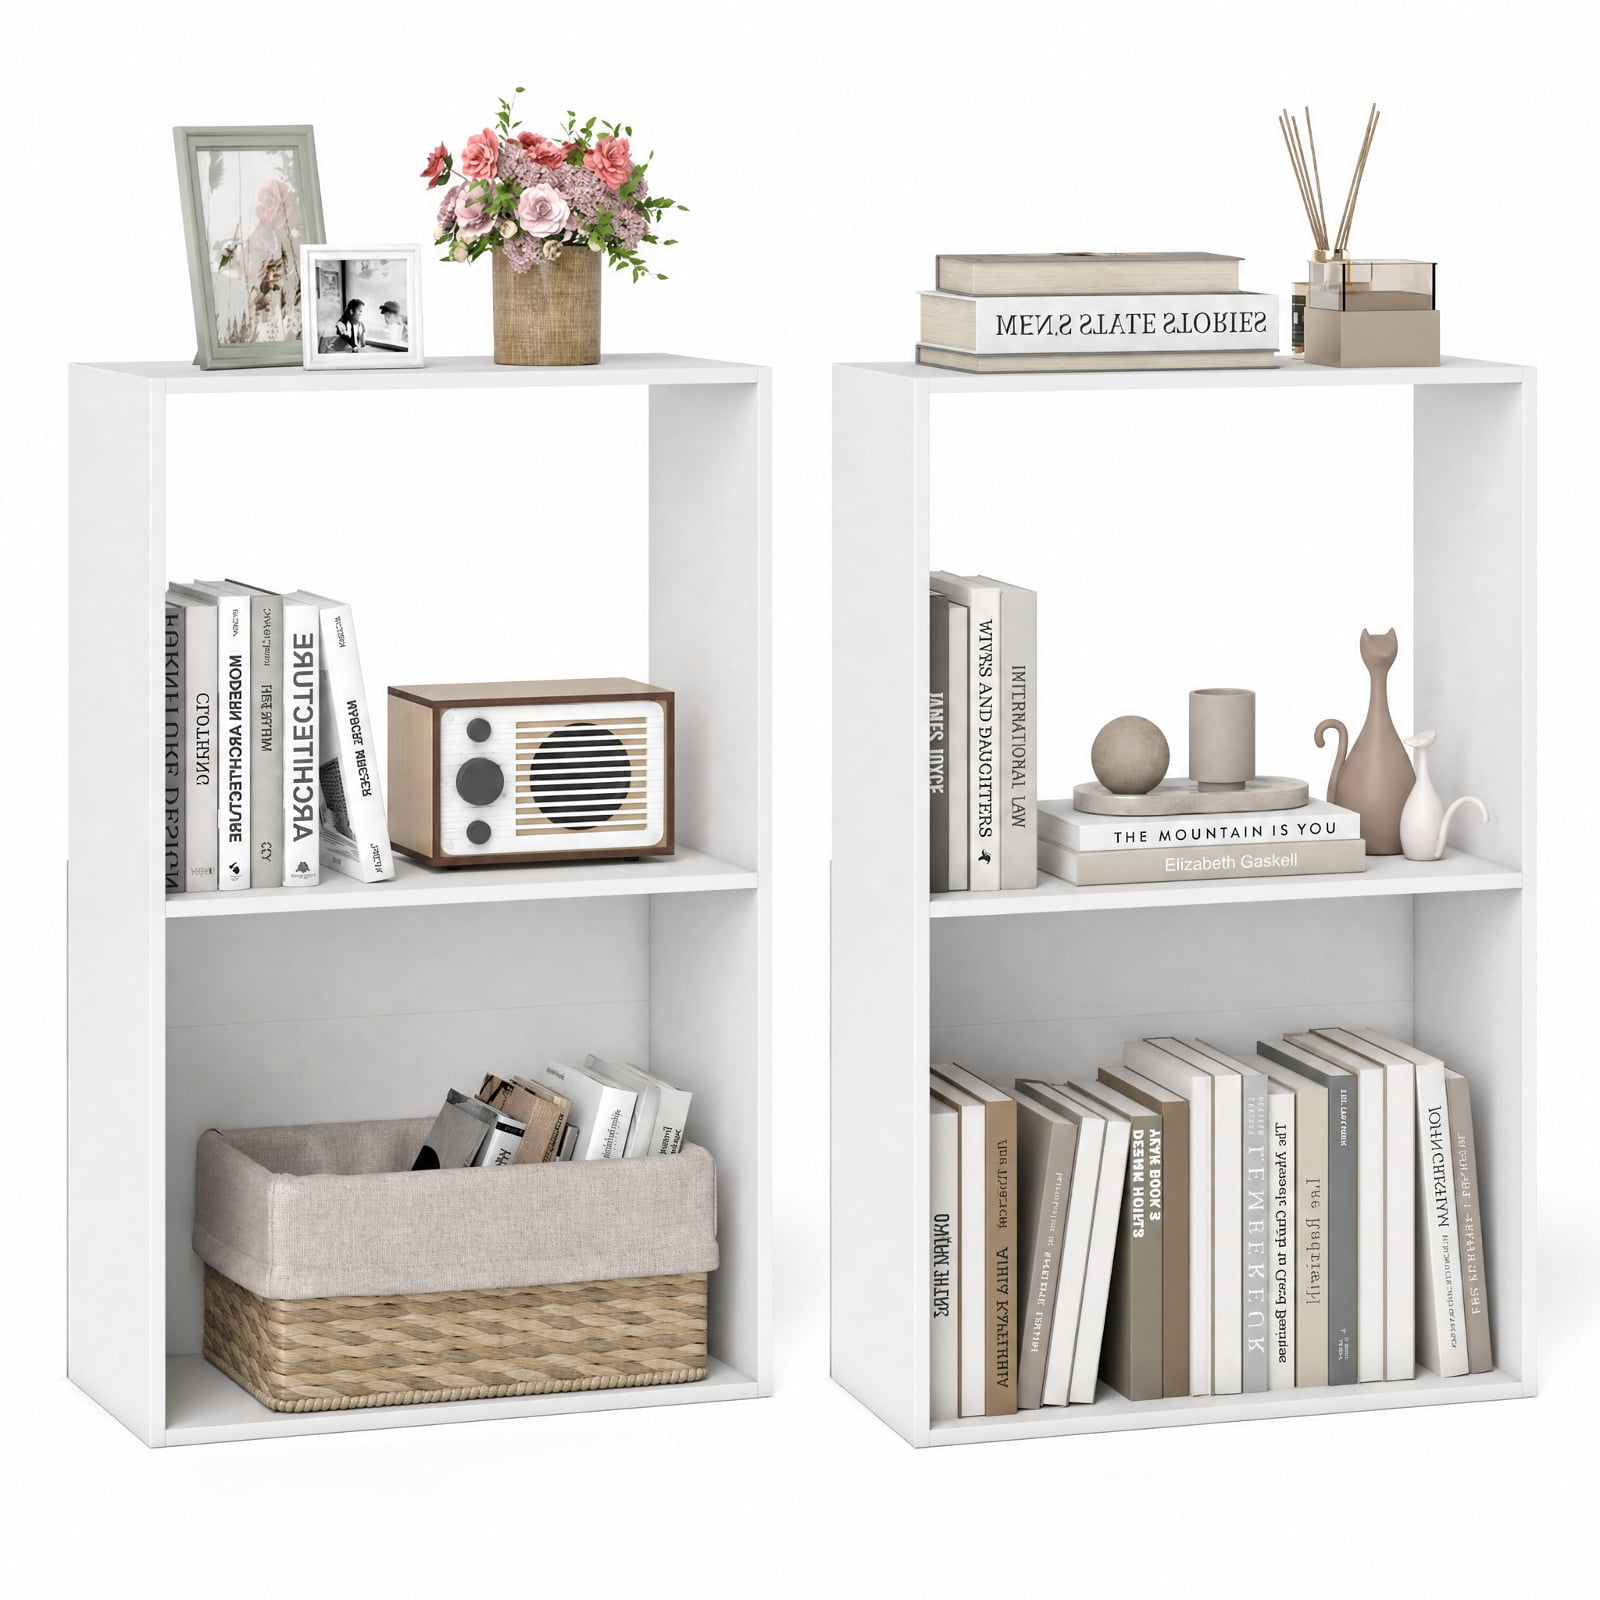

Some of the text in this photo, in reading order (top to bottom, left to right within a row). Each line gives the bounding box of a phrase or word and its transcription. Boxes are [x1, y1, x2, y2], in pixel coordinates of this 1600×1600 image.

[978, 682, 993, 723] AND
[1114, 822, 1336, 844] THE MOUNTAIN IS YOU
[1165, 850, 1299, 874] Elizabeth Gaskell
